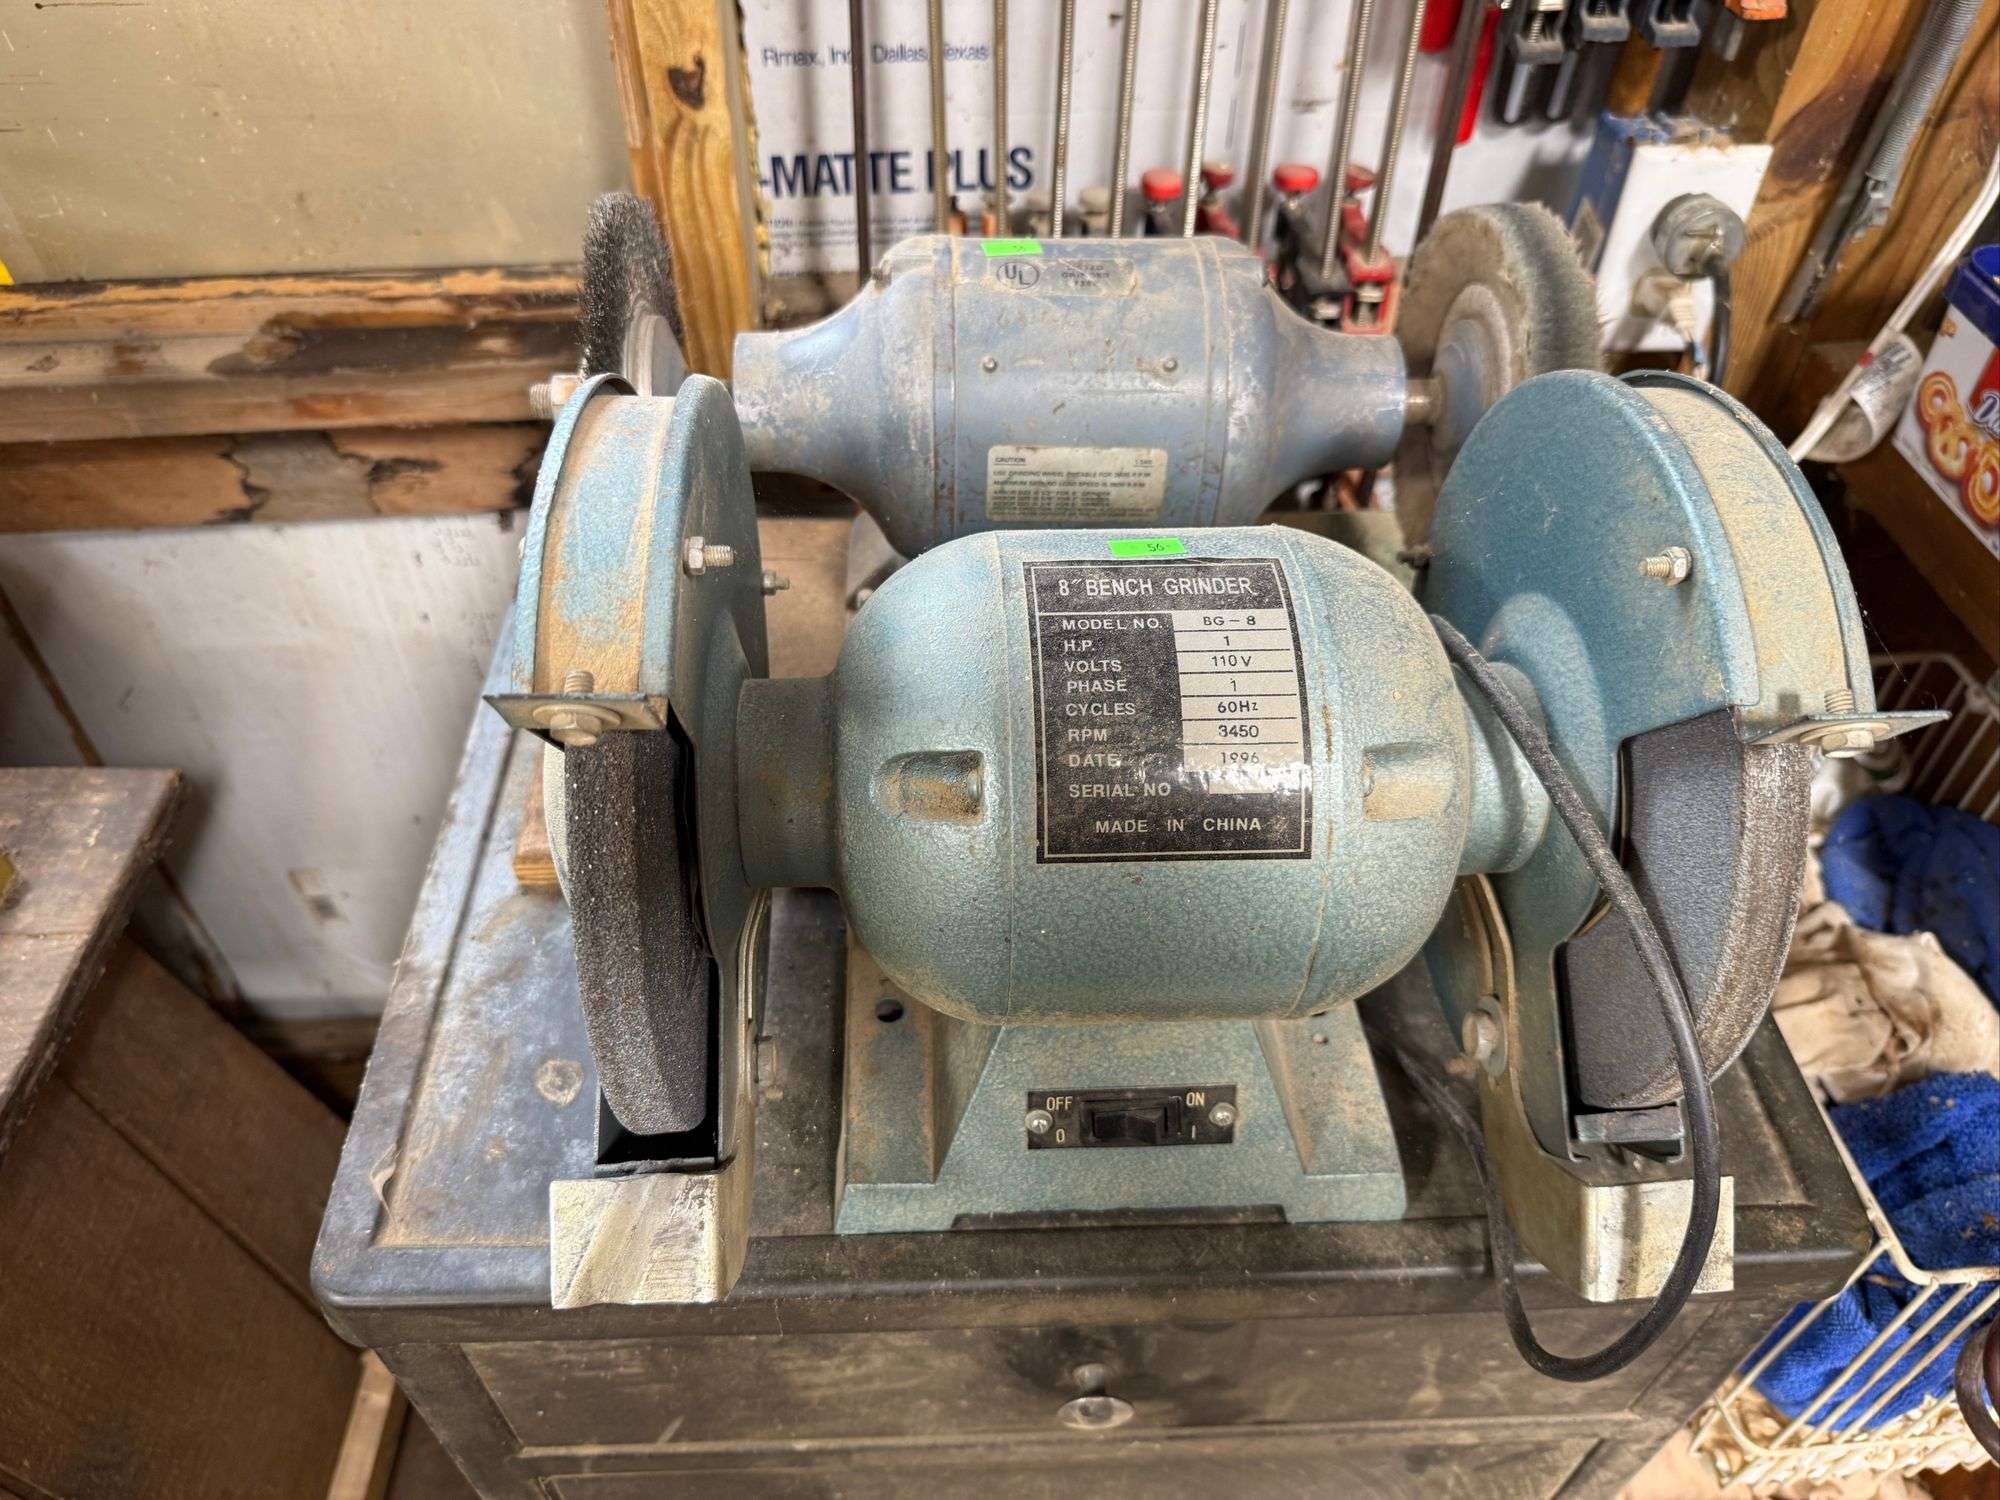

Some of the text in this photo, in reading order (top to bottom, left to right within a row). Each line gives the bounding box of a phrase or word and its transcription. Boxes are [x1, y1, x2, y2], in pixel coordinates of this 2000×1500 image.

[1164, 577, 1254, 595] GRINDER
[1062, 619, 1127, 630] MODEL
[1133, 618, 1163, 629] NO.
[1064, 635, 1230, 652] H.P. 1
[1064, 660, 1122, 672] VOLTS
[1067, 680, 1237, 693] PHASE 1
[1066, 702, 1136, 716] CYCLES
[1068, 725, 1259, 741] RPM 3450
[1068, 751, 1260, 767] DATE 1996
[1069, 782, 1171, 798] SERIAL NO
[1095, 817, 1261, 833] MADE IN CHINA
[1046, 1096, 1073, 1111] OFF
[1186, 1092, 1205, 1107] ON
